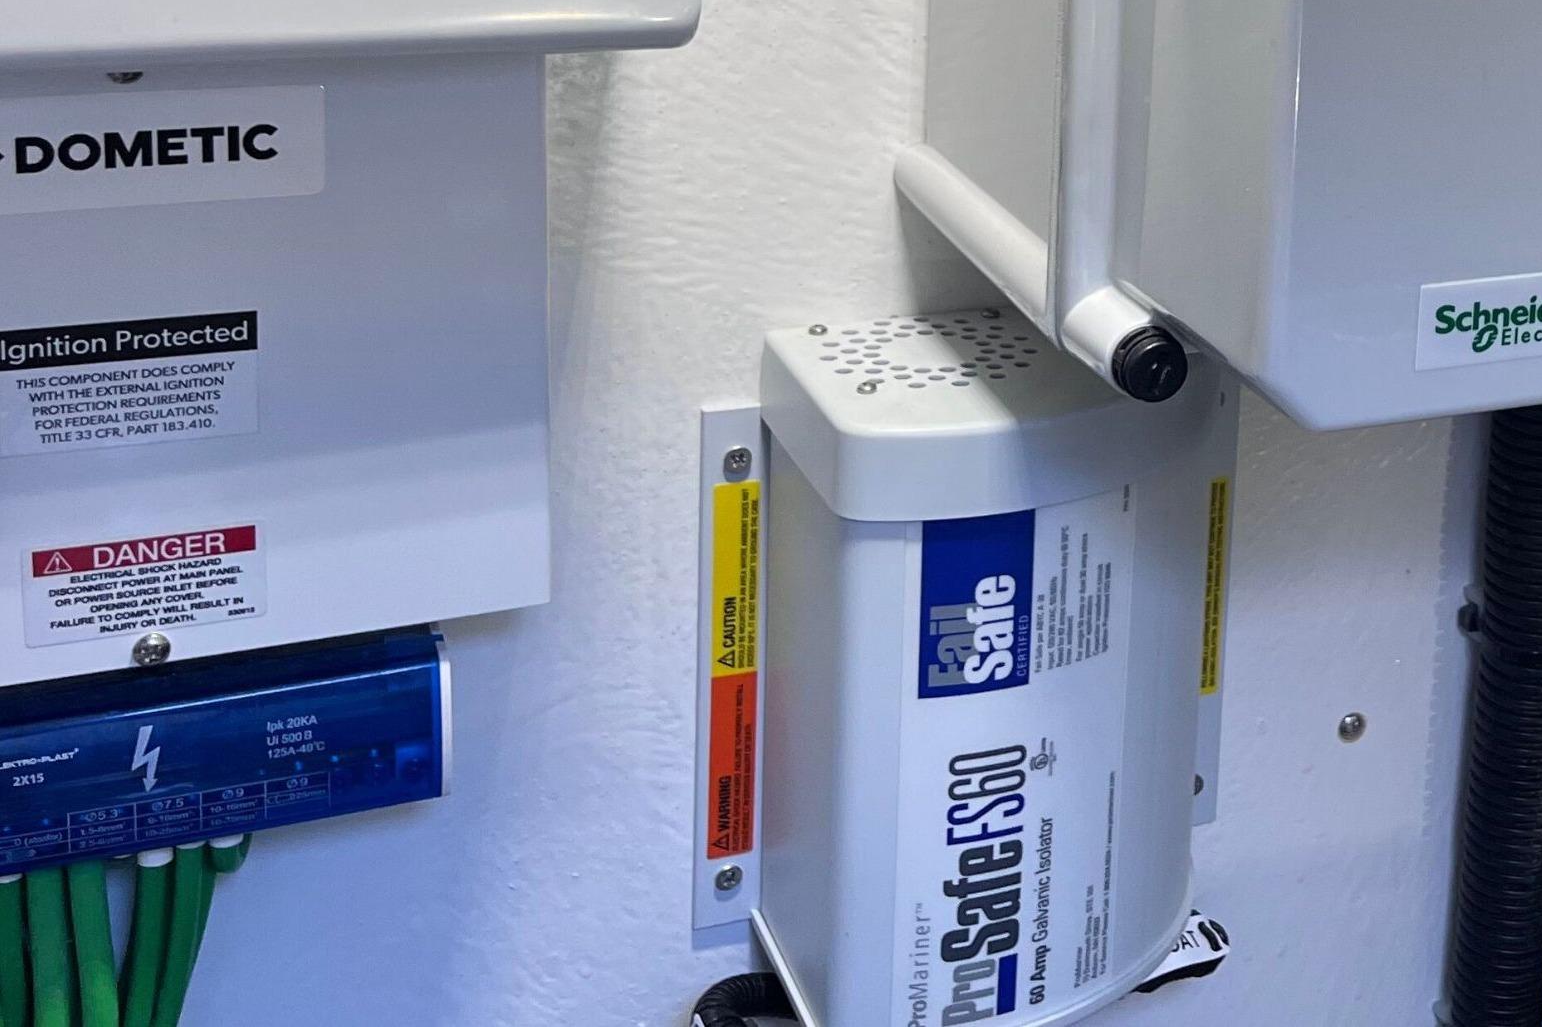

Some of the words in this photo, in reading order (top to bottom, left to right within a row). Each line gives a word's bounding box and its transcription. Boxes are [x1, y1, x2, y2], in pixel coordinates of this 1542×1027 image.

[14, 124, 279, 174] DOMETIC
[0, 335, 107, 365] Ignition
[116, 320, 248, 351] Protected
[16, 377, 46, 389] THIS
[49, 369, 138, 387] COMPONENT
[141, 365, 178, 378] DOES
[181, 361, 235, 375] COMPLY
[29, 390, 64, 402] WITH
[68, 386, 93, 399] THE
[96, 382, 162, 397] EXTERNAL
[164, 376, 225, 391] IGNITION
[32, 399, 117, 417] PROTECTION
[120, 389, 221, 409] REQUIREMENTS
[35, 420, 63, 430] FOR
[65, 412, 121, 428] FEDERAL
[40, 432, 72, 444] TITLE
[75, 430, 92, 440] 33
[127, 424, 158, 435] PART
[92, 532, 226, 568] DANGER
[49, 581, 119, 597] DISCONNECT
[121, 576, 160, 588] POWER
[163, 574, 177, 582] AT
[179, 571, 206, 580] MAIN
[209, 566, 243, 576] PANEL
[70, 569, 135, 583] ELECTRICAL
[138, 564, 176, 575] SHOCK
[178, 557, 221, 570] HAZARD
[55, 598, 72, 607] OR
[74, 592, 114, 605] POWER
[116, 586, 160, 599] SOURCE
[163, 582, 192, 592] INLET
[196, 577, 238, 589] BEFORE
[90, 600, 138, 613] OPENING
[141, 597, 163, 606] ANY
[50, 616, 95, 629] FAILURE
[97, 614, 112, 622] TO
[115, 607, 160, 620] COMPLY
[162, 604, 189, 614] WILL
[190, 598, 230, 610] RESULT
[100, 621, 138, 633] INJURY
[141, 619, 156, 627] OR
[723, 597, 737, 649] CAUTION
[963, 574, 1016, 684] Safe
[927, 602, 981, 688] Fail
[1017, 614, 1029, 677] CERTIFIED
[281, 733, 302, 744] 500
[13, 773, 44, 787] 2X15
[718, 775, 732, 833] WARNING
[1037, 817, 1052, 874] Isolator
[1032, 875, 1050, 943] Galvanic
[1032, 943, 1050, 981] Amp
[1029, 983, 1045, 1006] 60
